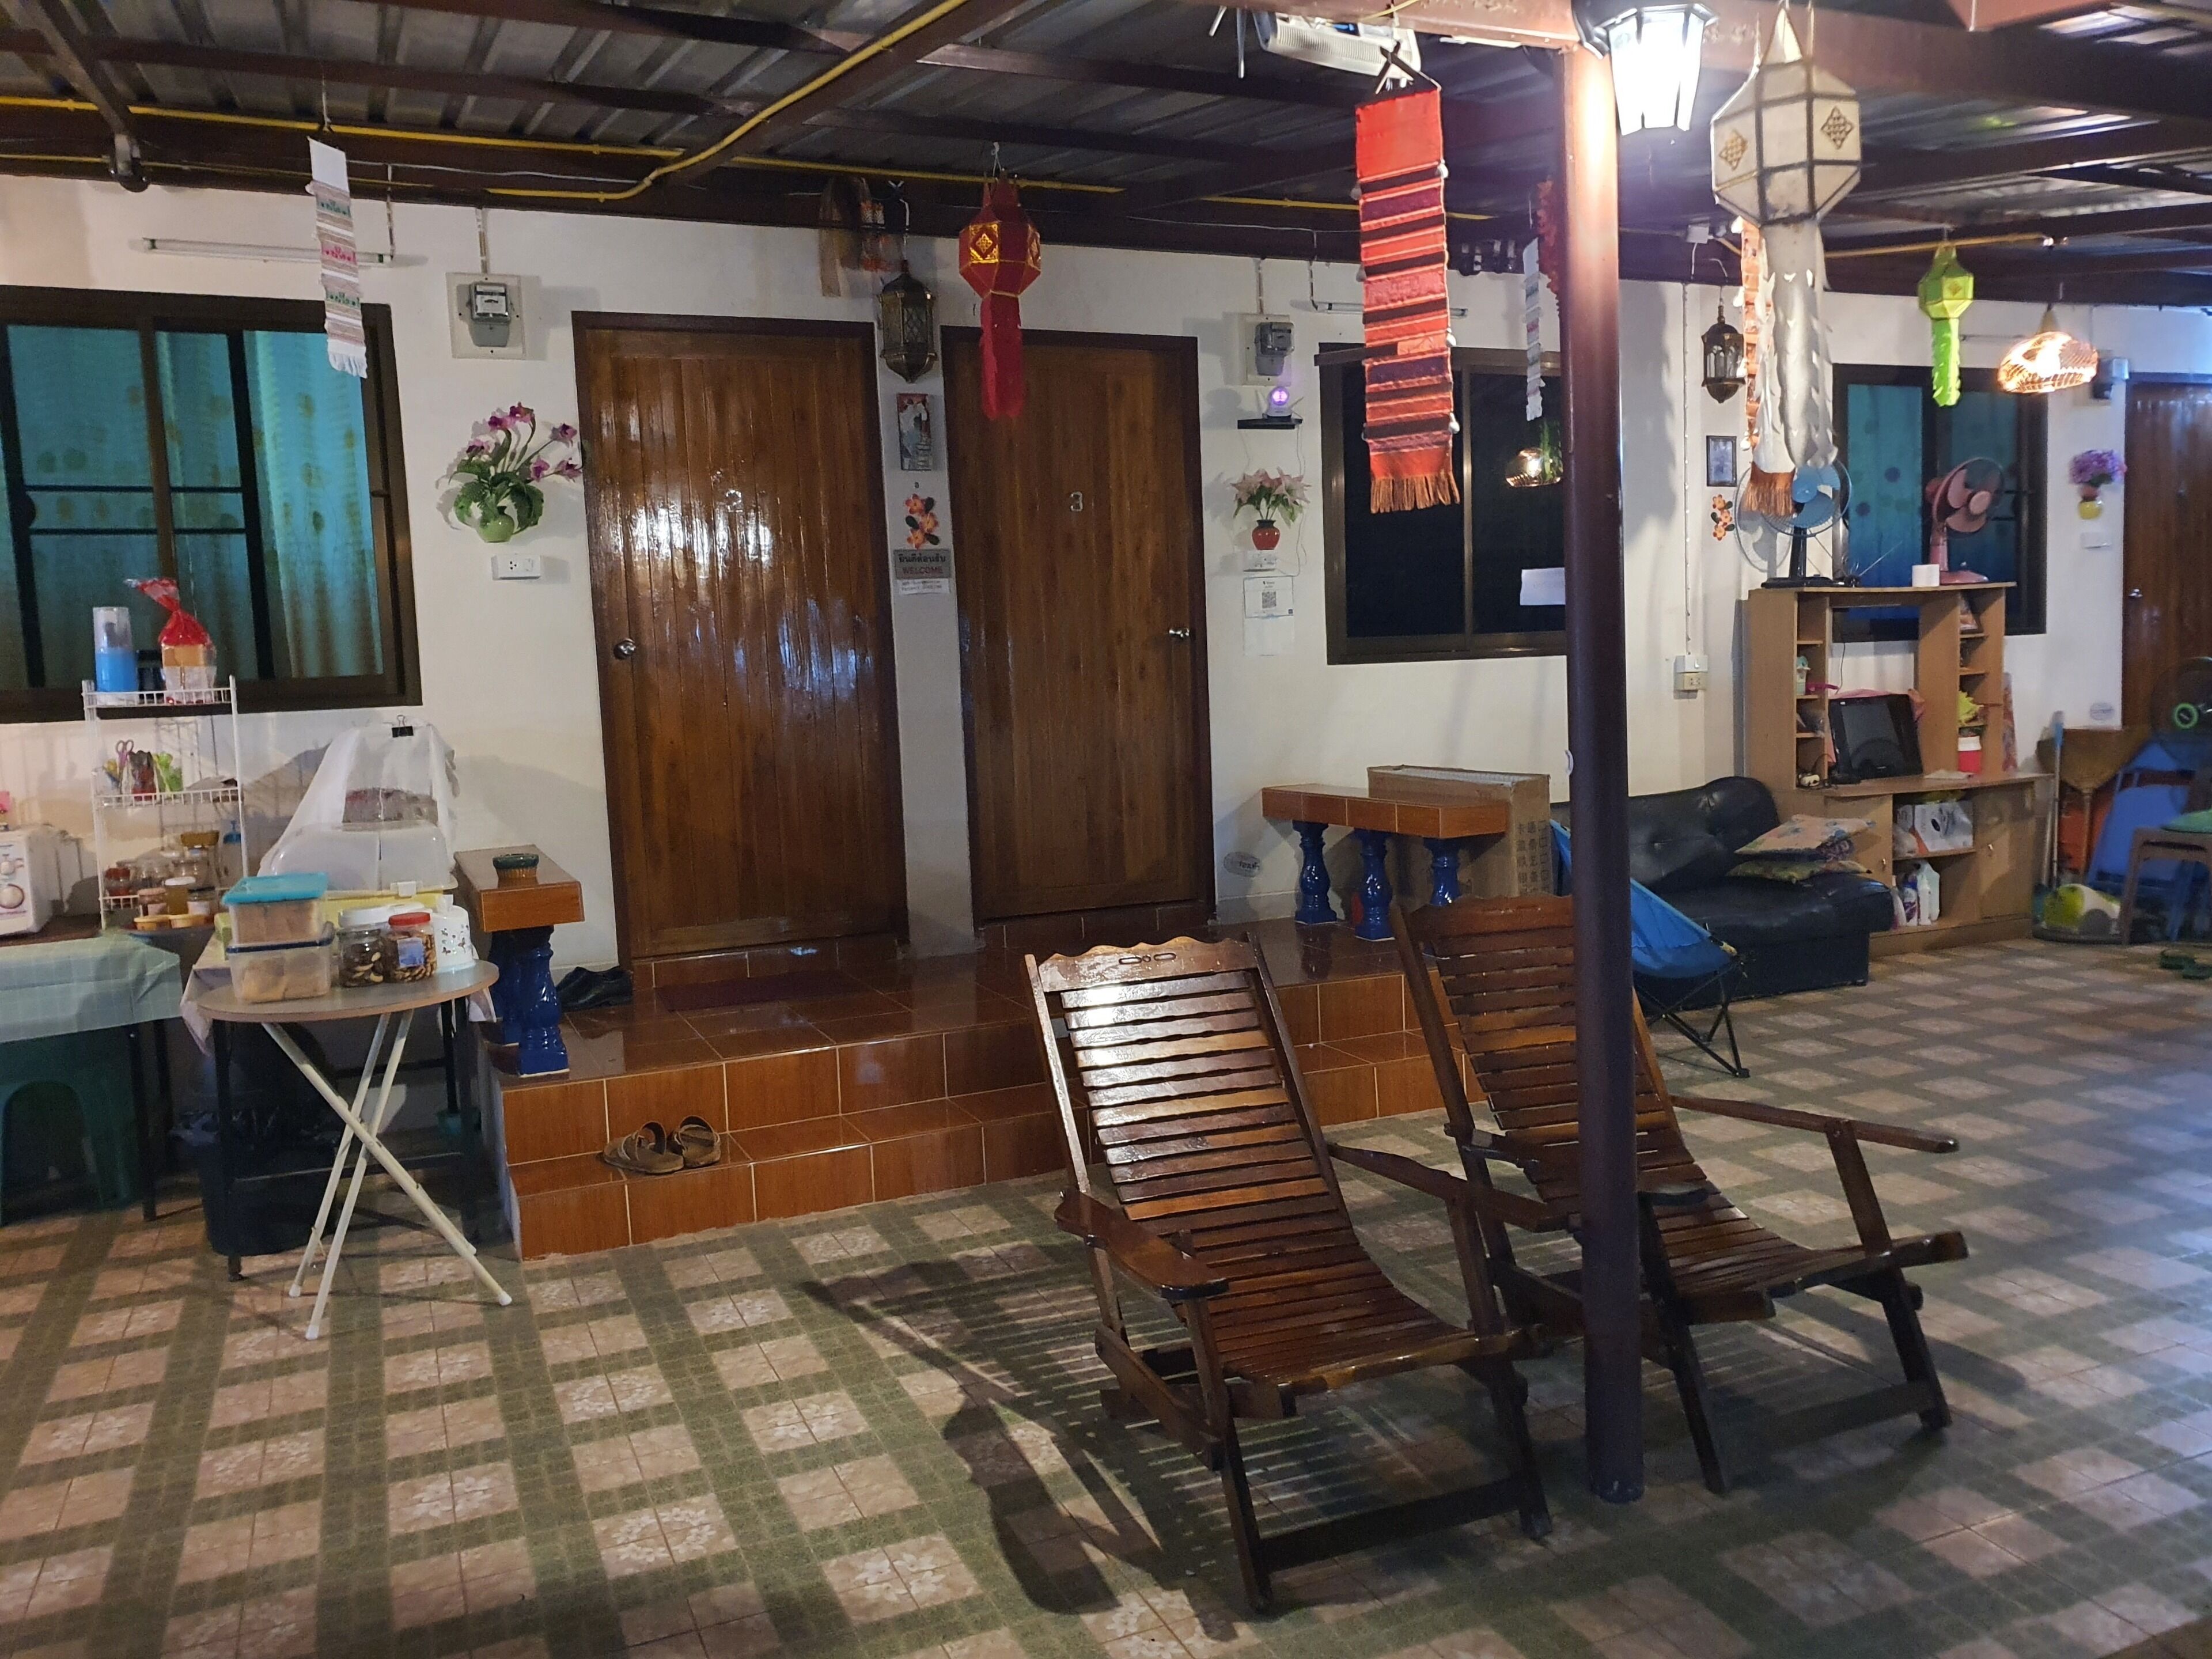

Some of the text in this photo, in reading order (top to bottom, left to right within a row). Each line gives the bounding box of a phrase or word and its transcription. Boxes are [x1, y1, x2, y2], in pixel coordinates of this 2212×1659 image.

[725, 490, 743, 513] 2
[1070, 491, 1083, 512] 3
[902, 566, 944, 574] WELCOME
